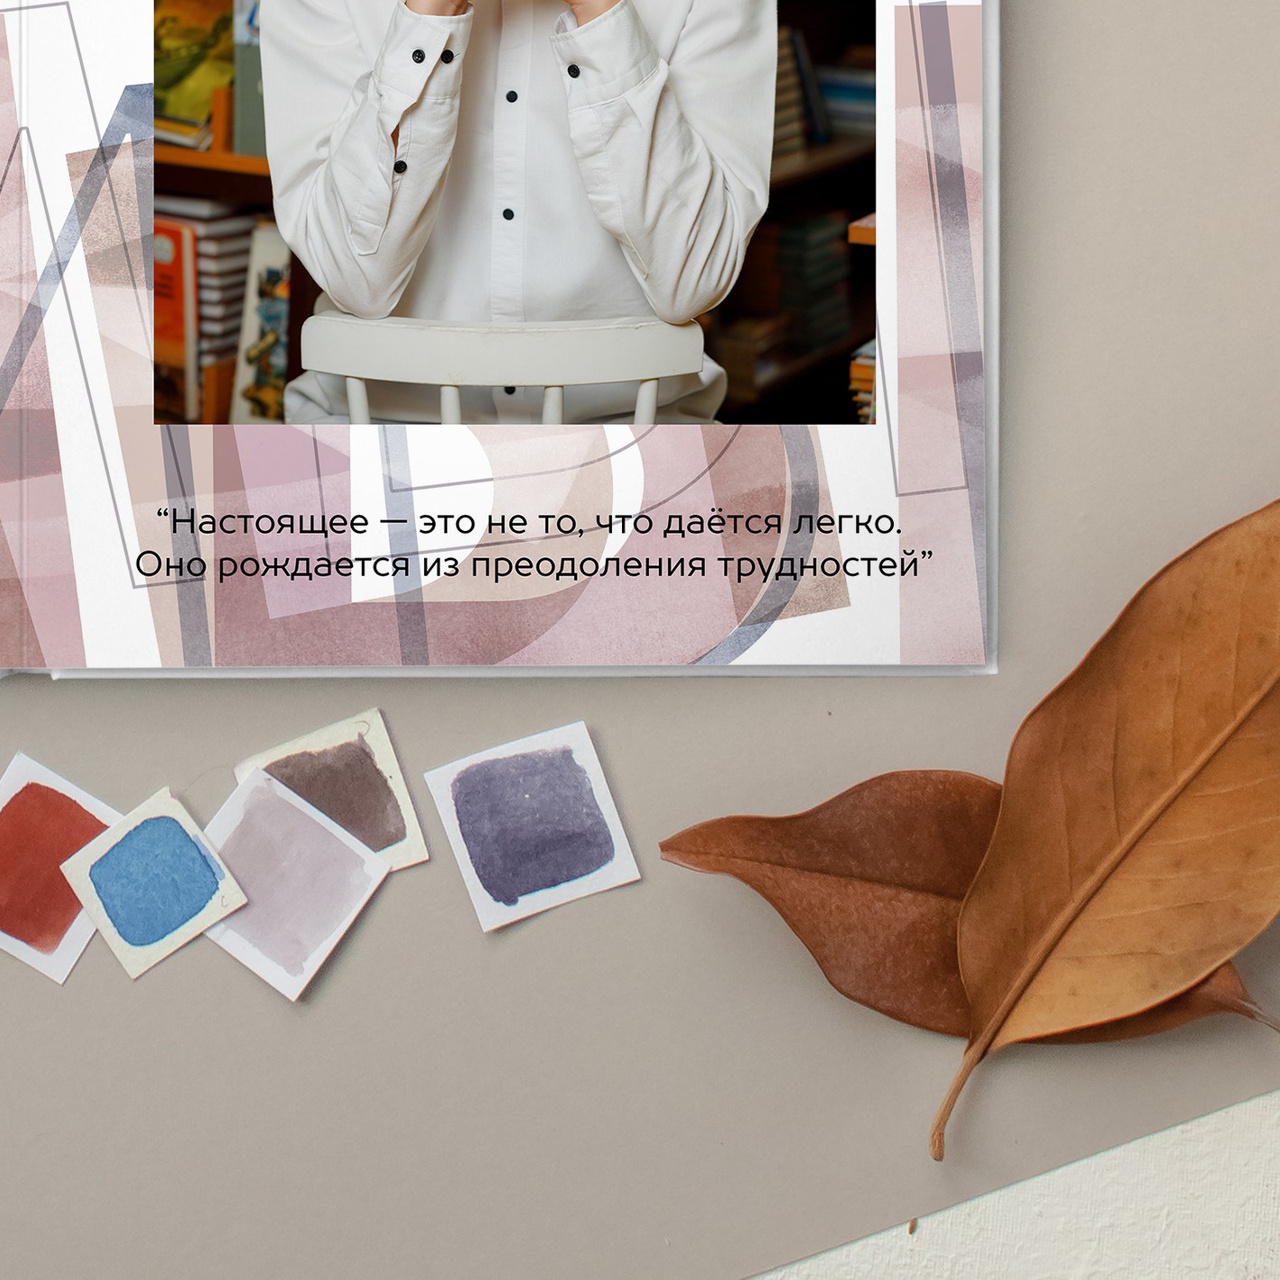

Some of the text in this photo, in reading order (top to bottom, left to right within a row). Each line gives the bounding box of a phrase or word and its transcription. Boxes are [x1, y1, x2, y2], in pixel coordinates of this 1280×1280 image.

[158, 507, 368, 538] “Настоящее
[420, 515, 474, 534] это
[489, 515, 527, 533] не
[539, 515, 583, 538] то,
[597, 515, 652, 534] что
[664, 508, 781, 538] даётся
[793, 515, 901, 534] легко.
[136, 550, 932, 583] Оно рождается из преодоления трудностей”
